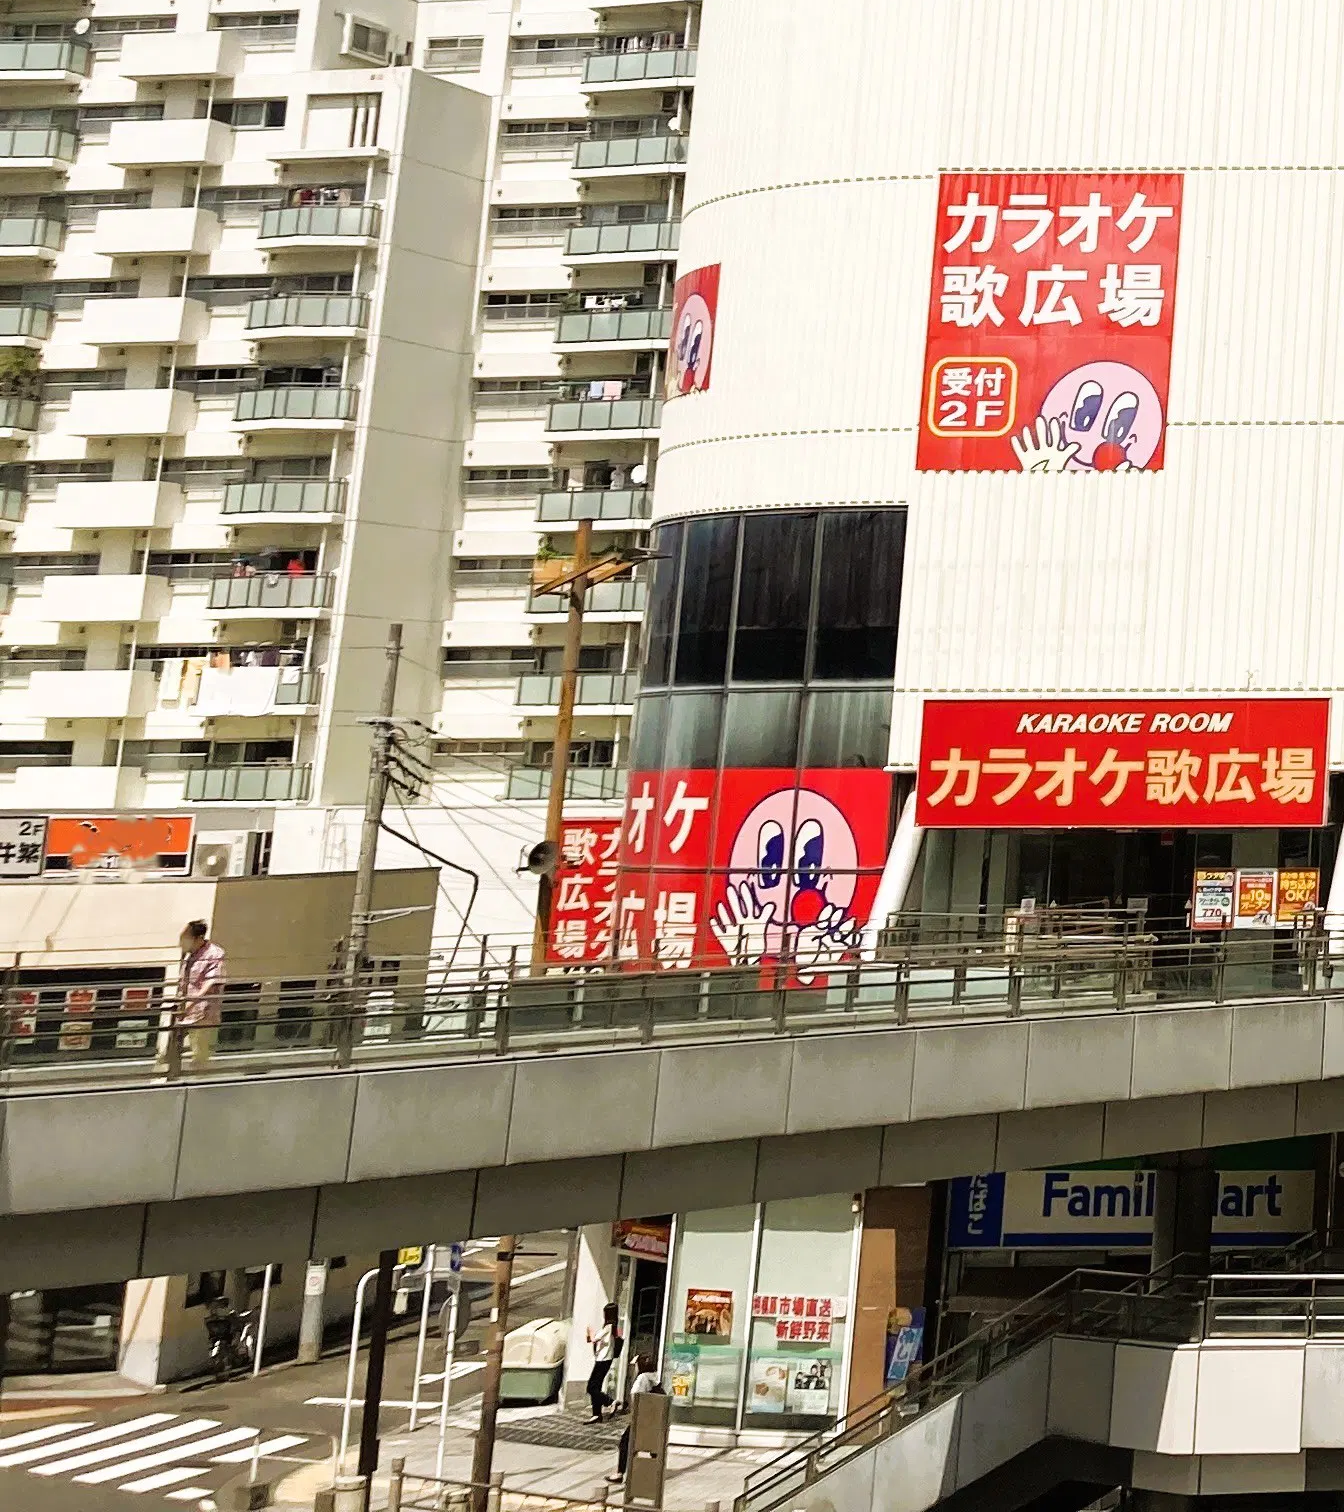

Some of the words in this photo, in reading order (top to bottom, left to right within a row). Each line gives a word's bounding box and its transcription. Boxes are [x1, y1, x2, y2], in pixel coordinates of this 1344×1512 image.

[942, 192, 1175, 254] カラオケ
[940, 263, 1166, 329] 歌広場
[940, 366, 1007, 398] 受付
[938, 399, 1006, 428] 2F
[1015, 711, 1147, 734] KARAOKE
[1149, 711, 1235, 734] ROOM
[926, 746, 1317, 808] カラオケ歌広場
[18, 821, 44, 836] 2F
[552, 827, 598, 960] 歌広場
